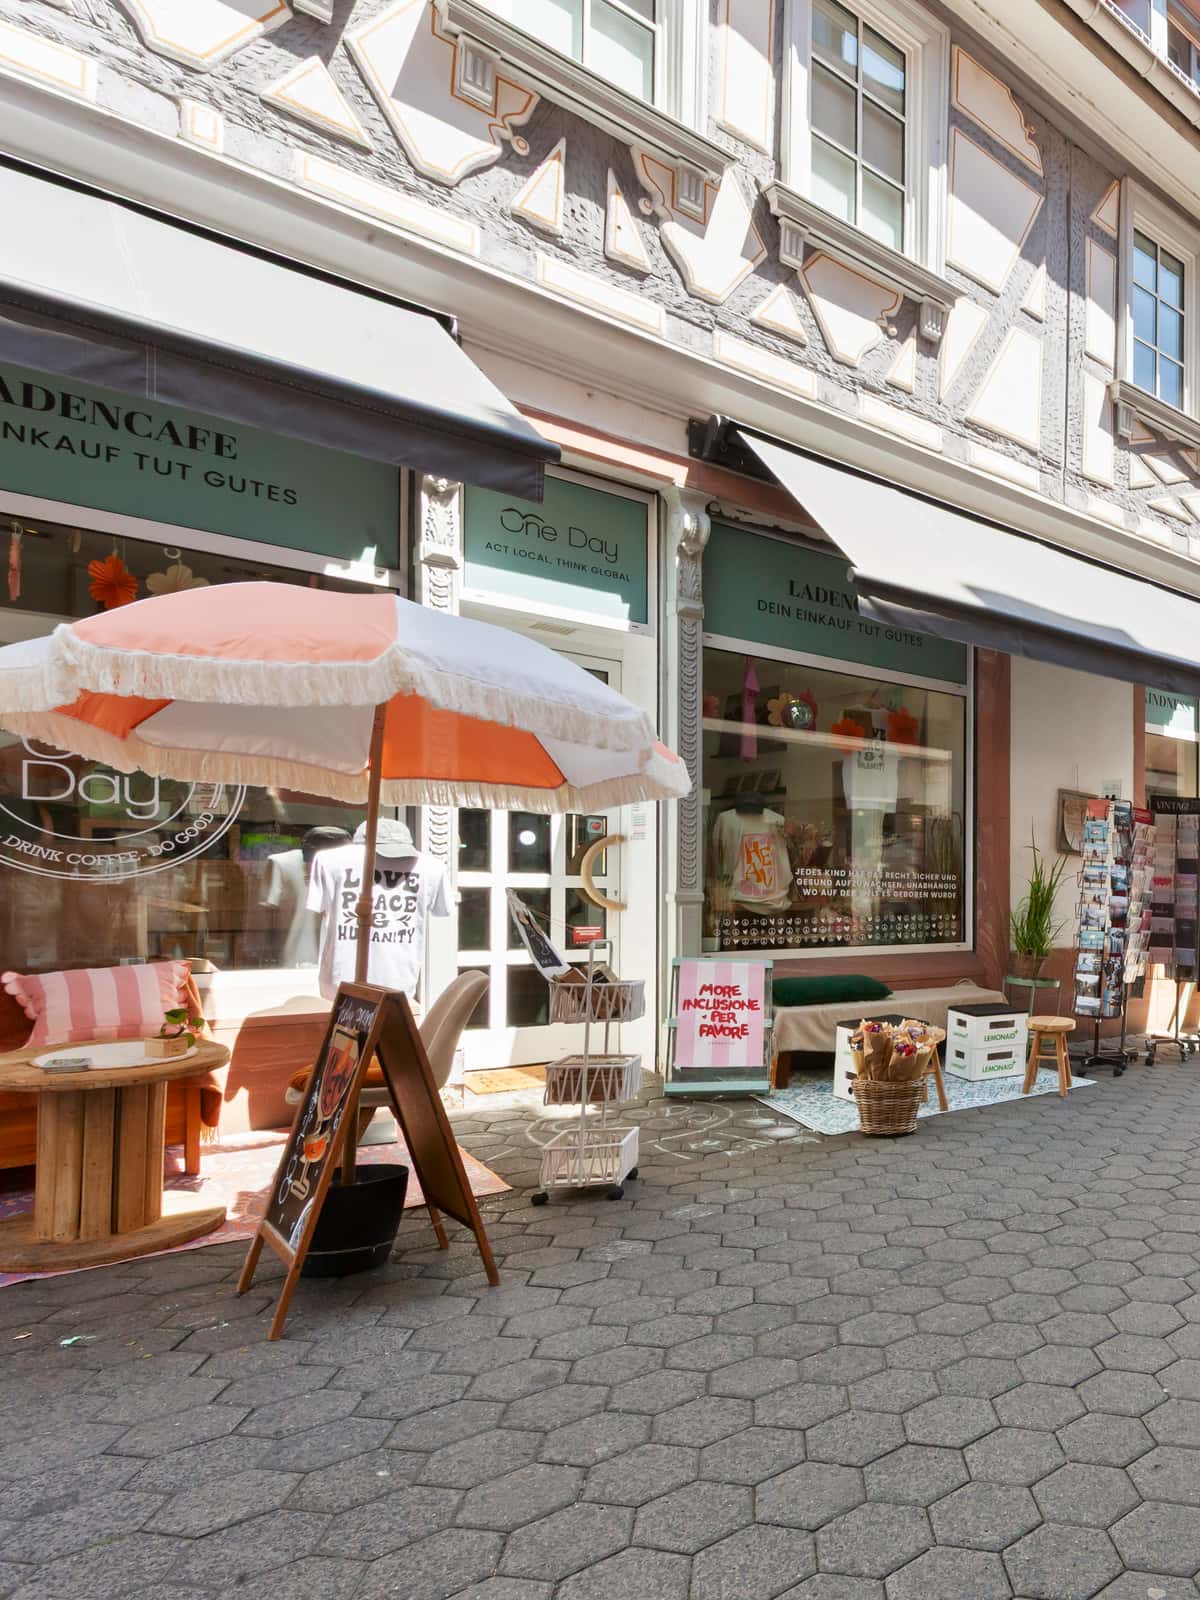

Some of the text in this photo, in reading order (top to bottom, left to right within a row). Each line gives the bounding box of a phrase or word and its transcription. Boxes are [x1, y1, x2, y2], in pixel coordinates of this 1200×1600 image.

[133, 452, 192, 480] TUT
[203, 470, 298, 505] GUTES
[500, 508, 618, 563] One Day
[485, 541, 508, 553] ACT
[556, 558, 588, 573] THINK
[591, 566, 631, 583] GLOBAL
[757, 599, 923, 647] DEIN EINKAUF TUT GUTES
[22, 760, 160, 820] Day
[2, 834, 64, 863] DRINK
[149, 840, 175, 856] DO
[175, 811, 214, 844] GOOD
[795, 868, 821, 876] JEDES
[825, 869, 846, 877] KIND
[885, 872, 910, 880] RECHT
[913, 873, 939, 881] SICHER
[796, 878, 832, 887] GESUND
[342, 891, 417, 913] PACE
[803, 888, 818, 896] WO
[821, 888, 837, 896] AUF
[893, 890, 928, 898] GEBOREN
[930, 890, 957, 899] WURDE
[338, 925, 415, 944] HUANITY
[699, 984, 742, 998] MORE
[682, 998, 760, 1011] INCLUSIONE
[710, 1011, 737, 1024] PER
[699, 1024, 750, 1040] FAVORE
